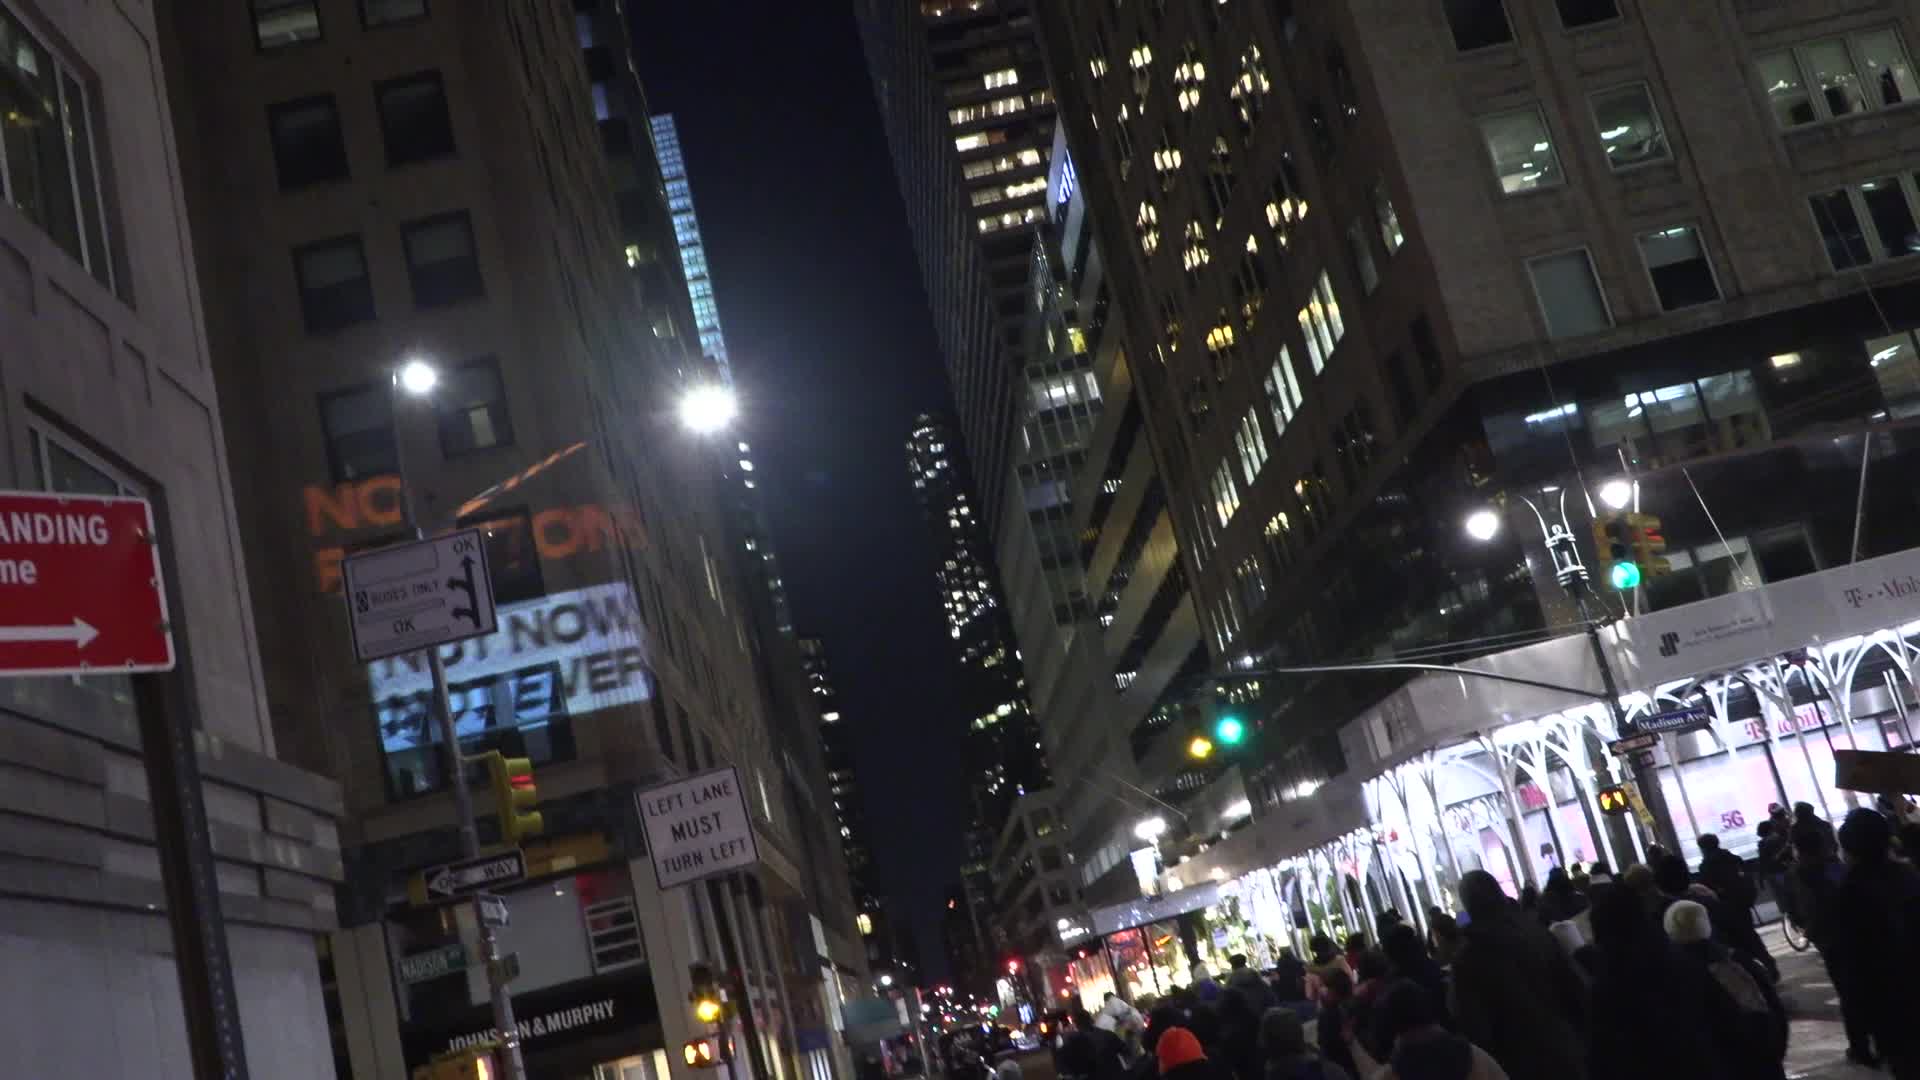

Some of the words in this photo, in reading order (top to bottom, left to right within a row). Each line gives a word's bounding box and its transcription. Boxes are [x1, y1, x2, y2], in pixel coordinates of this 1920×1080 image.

[453, 538, 475, 555] OK
[412, 579, 440, 597] ONLY
[393, 617, 415, 635] OK
[508, 595, 632, 652] NOW
[1639, 715, 1685, 731] Madison
[1685, 711, 1707, 723] Ave
[648, 793, 684, 817] LEFT
[691, 783, 733, 805] LANE
[671, 812, 721, 842] MUST
[1719, 809, 1746, 831] 5G
[661, 851, 704, 873] TURN
[710, 839, 746, 862] LEFT
[483, 858, 514, 879] WAY
[400, 953, 449, 979] MADISON
